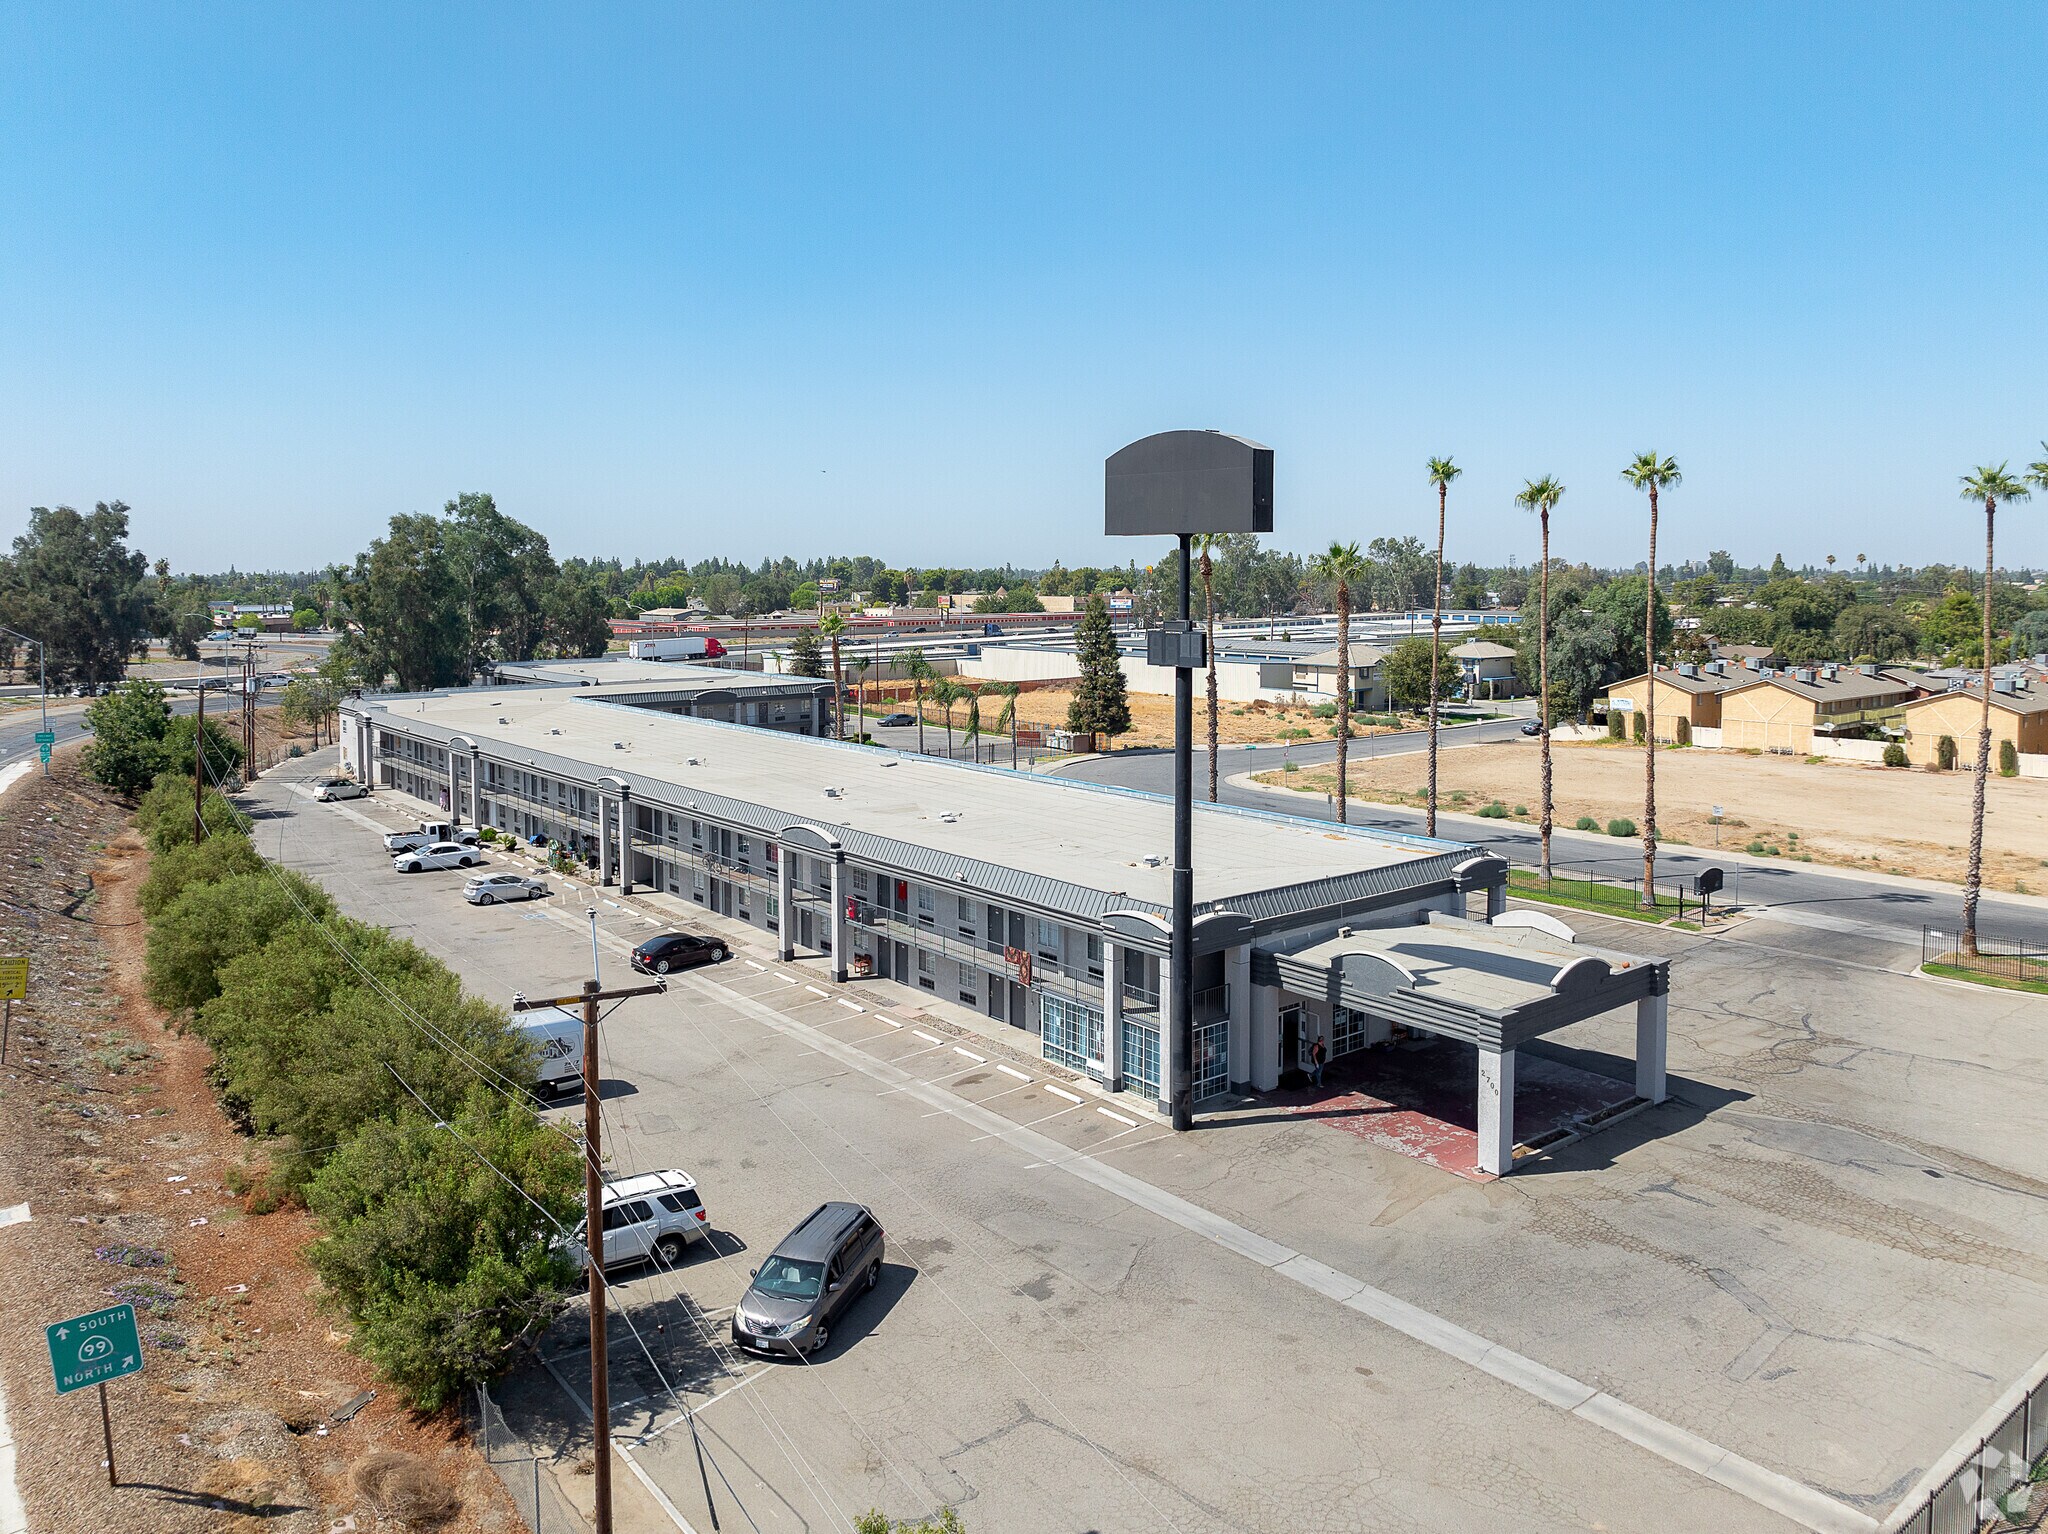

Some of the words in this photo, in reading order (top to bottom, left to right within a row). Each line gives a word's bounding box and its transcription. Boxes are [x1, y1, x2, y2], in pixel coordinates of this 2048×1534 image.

[1481, 1069, 1499, 1096] 2700
[79, 1311, 126, 1332] SOUTH
[84, 1341, 106, 1356] 99
[63, 1363, 113, 1385] NORTH
